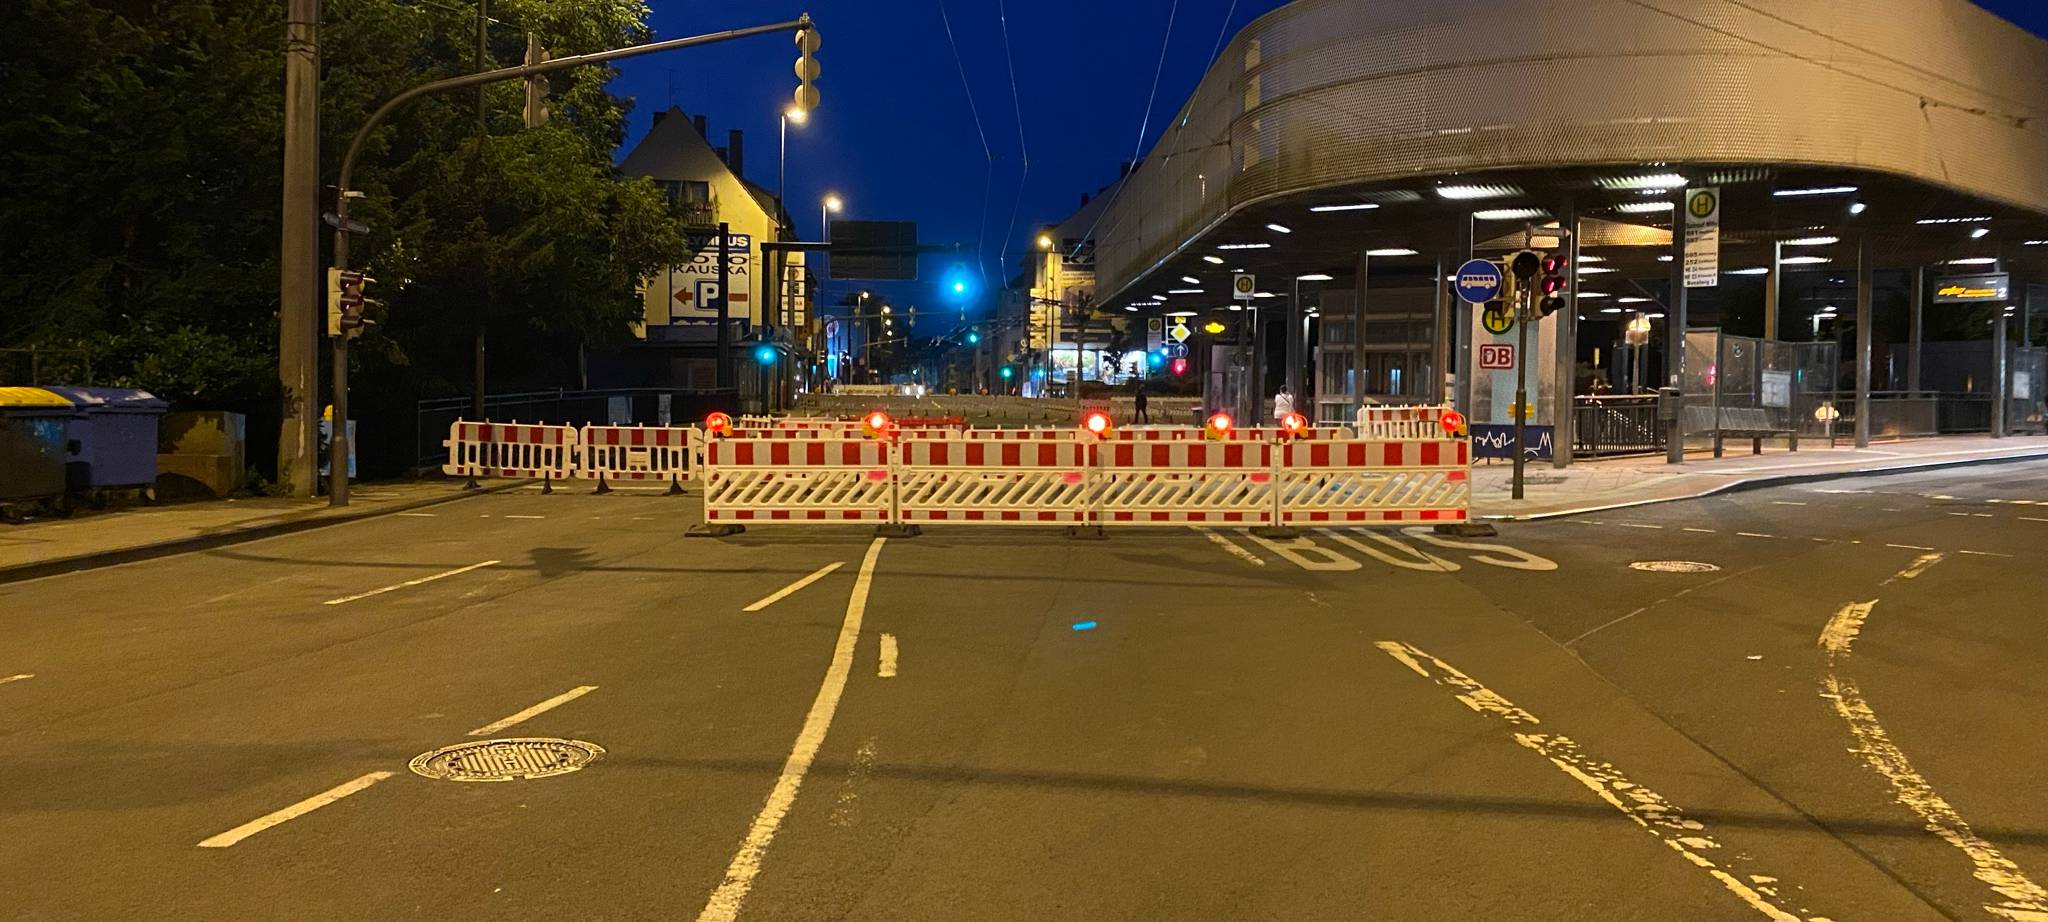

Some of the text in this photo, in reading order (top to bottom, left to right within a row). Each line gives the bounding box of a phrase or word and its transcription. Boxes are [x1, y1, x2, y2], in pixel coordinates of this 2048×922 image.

[1697, 197, 1708, 213] H
[692, 255, 748, 265] OTO
[700, 282, 719, 308] P
[1491, 310, 1505, 328] H
[1483, 348, 1510, 365] DB
[1236, 526, 1558, 572] BUS
